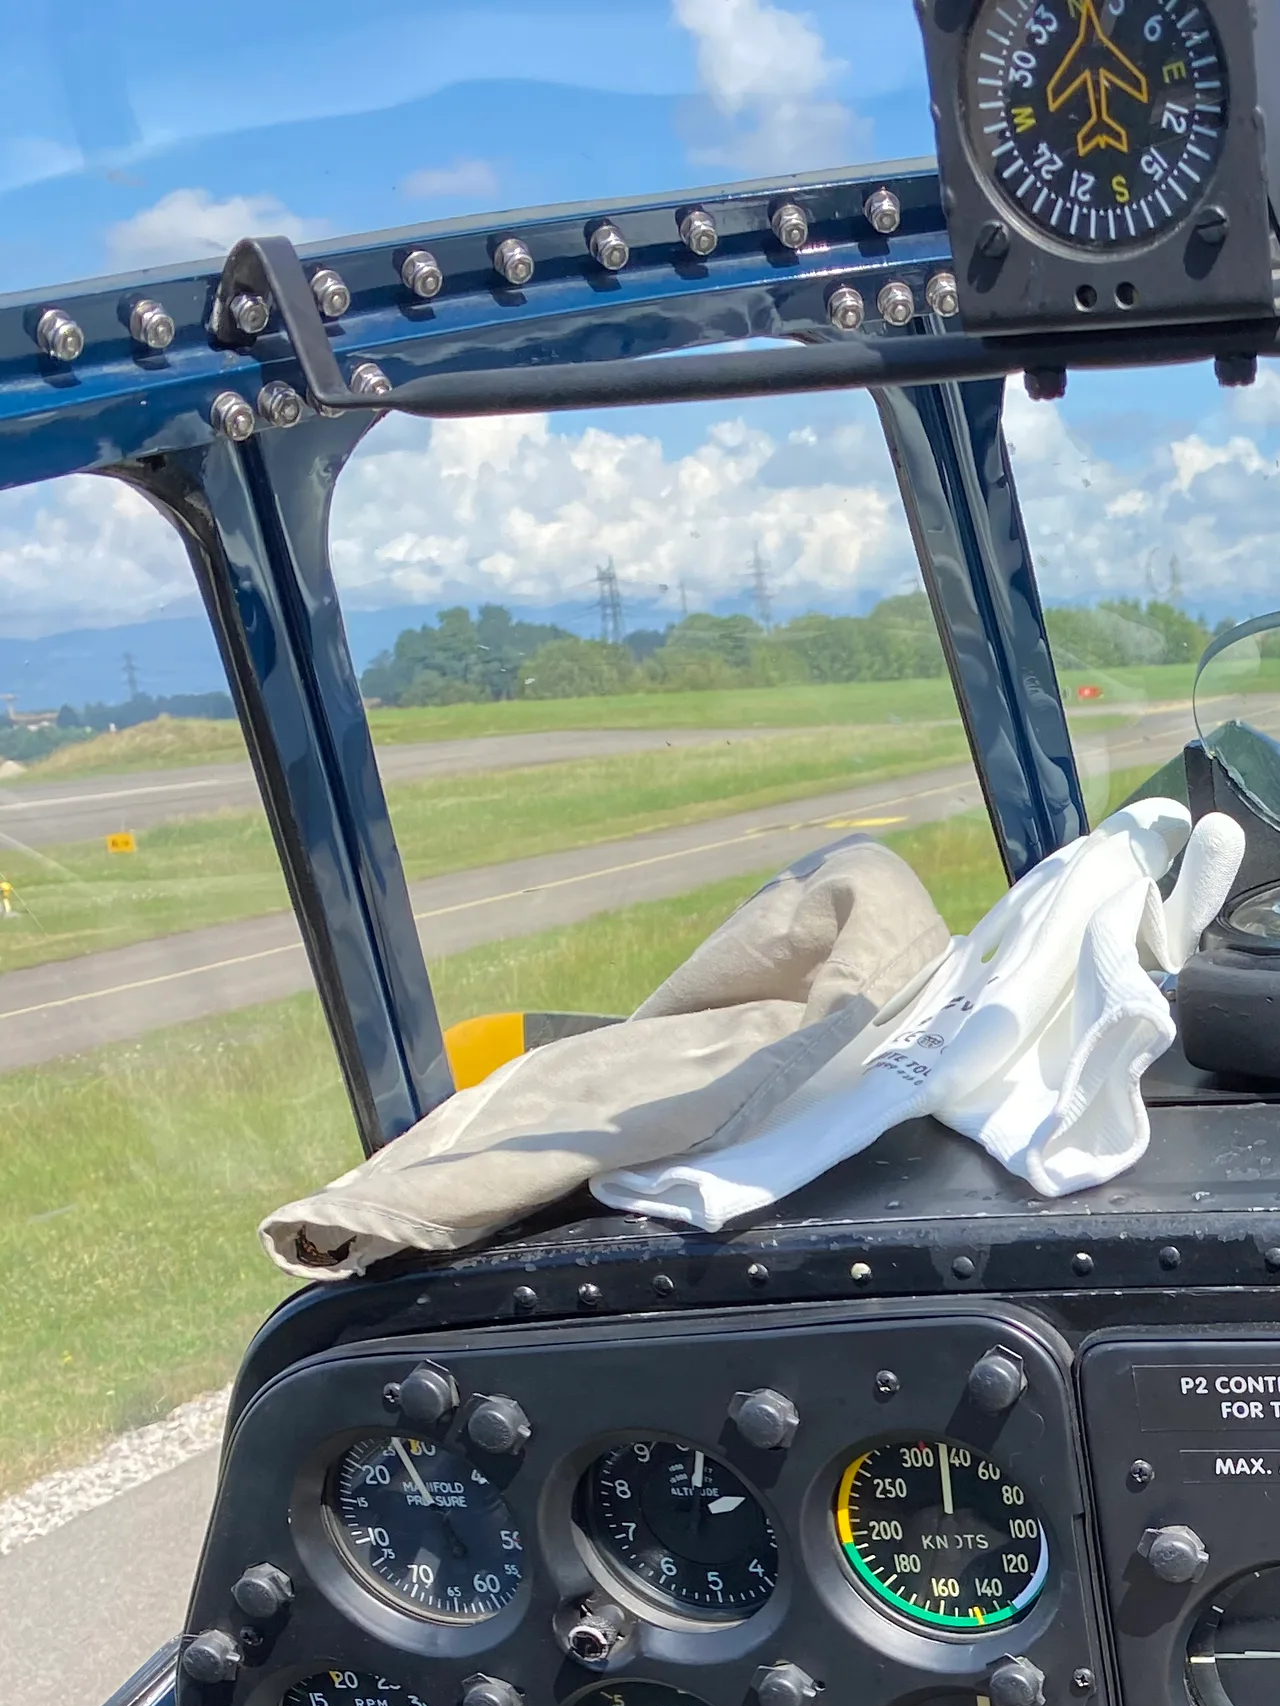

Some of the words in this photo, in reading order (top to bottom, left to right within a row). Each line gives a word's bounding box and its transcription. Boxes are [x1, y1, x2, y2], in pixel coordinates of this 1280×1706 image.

[1026, 5, 1059, 46] 33
[1008, 51, 1037, 88] 30
[1162, 62, 1187, 83] E
[1011, 106, 1037, 134] W
[1161, 102, 1190, 135] 12
[1033, 143, 1062, 181] 24
[1141, 148, 1168, 182] 15
[1070, 170, 1095, 202] 21
[1180, 1377, 1208, 1395] P2
[1220, 1401, 1264, 1419] FOR
[900, 1449, 934, 1467] 300
[950, 1449, 971, 1467] 40
[1215, 1458, 1272, 1475] MAX.
[978, 1461, 1000, 1480] 60
[874, 1478, 906, 1498] 250
[1002, 1486, 1024, 1505] 80
[869, 1521, 902, 1540] 200
[1010, 1519, 1037, 1538] 100
[894, 1554, 921, 1573] 180
[1003, 1554, 1029, 1573] 120
[931, 1578, 959, 1597] 160
[975, 1578, 1002, 1596] 140
